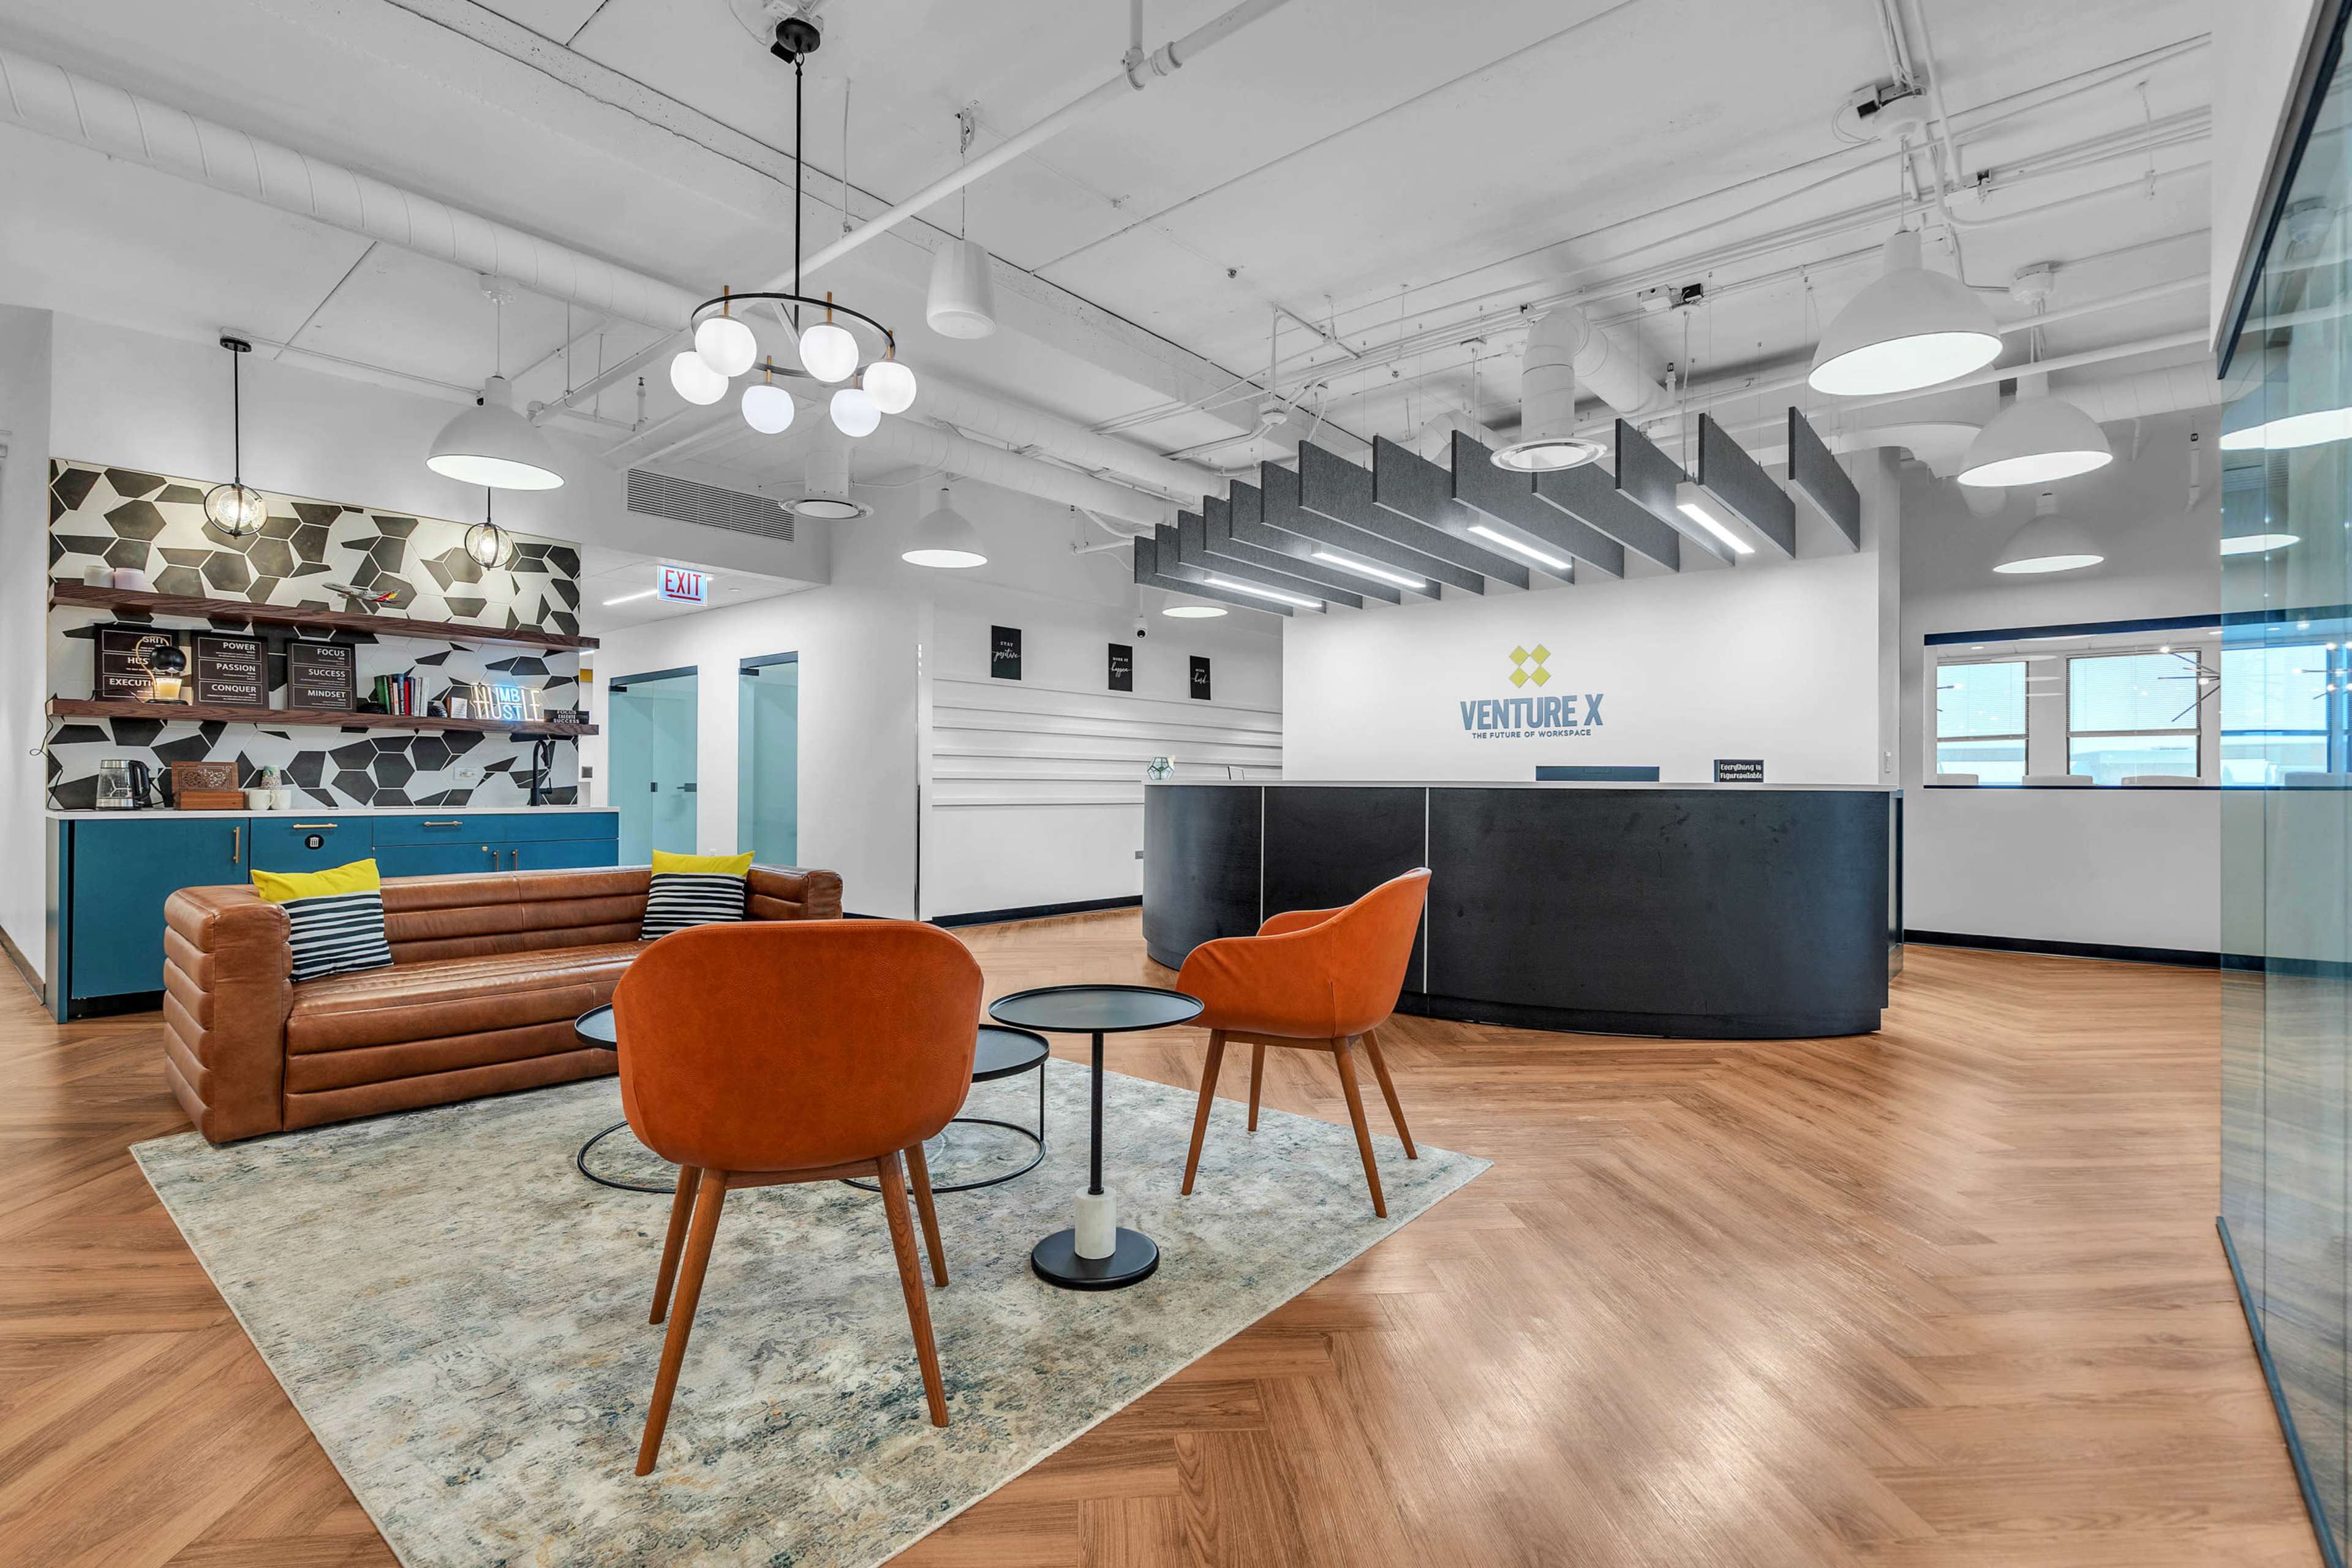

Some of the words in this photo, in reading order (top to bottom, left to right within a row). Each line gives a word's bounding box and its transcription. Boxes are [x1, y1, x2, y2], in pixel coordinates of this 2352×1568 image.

[665, 569, 701, 596] EXIT
[223, 642, 255, 650] POWER
[216, 663, 256, 672] PASSION
[308, 668, 345, 677] SUCCESS
[211, 684, 257, 693] CONQUER
[307, 690, 346, 698] MINDSET
[1460, 695, 1577, 730] VENTURE
[1583, 694, 1604, 726] X
[1538, 729, 1591, 737] WORKSPACE
